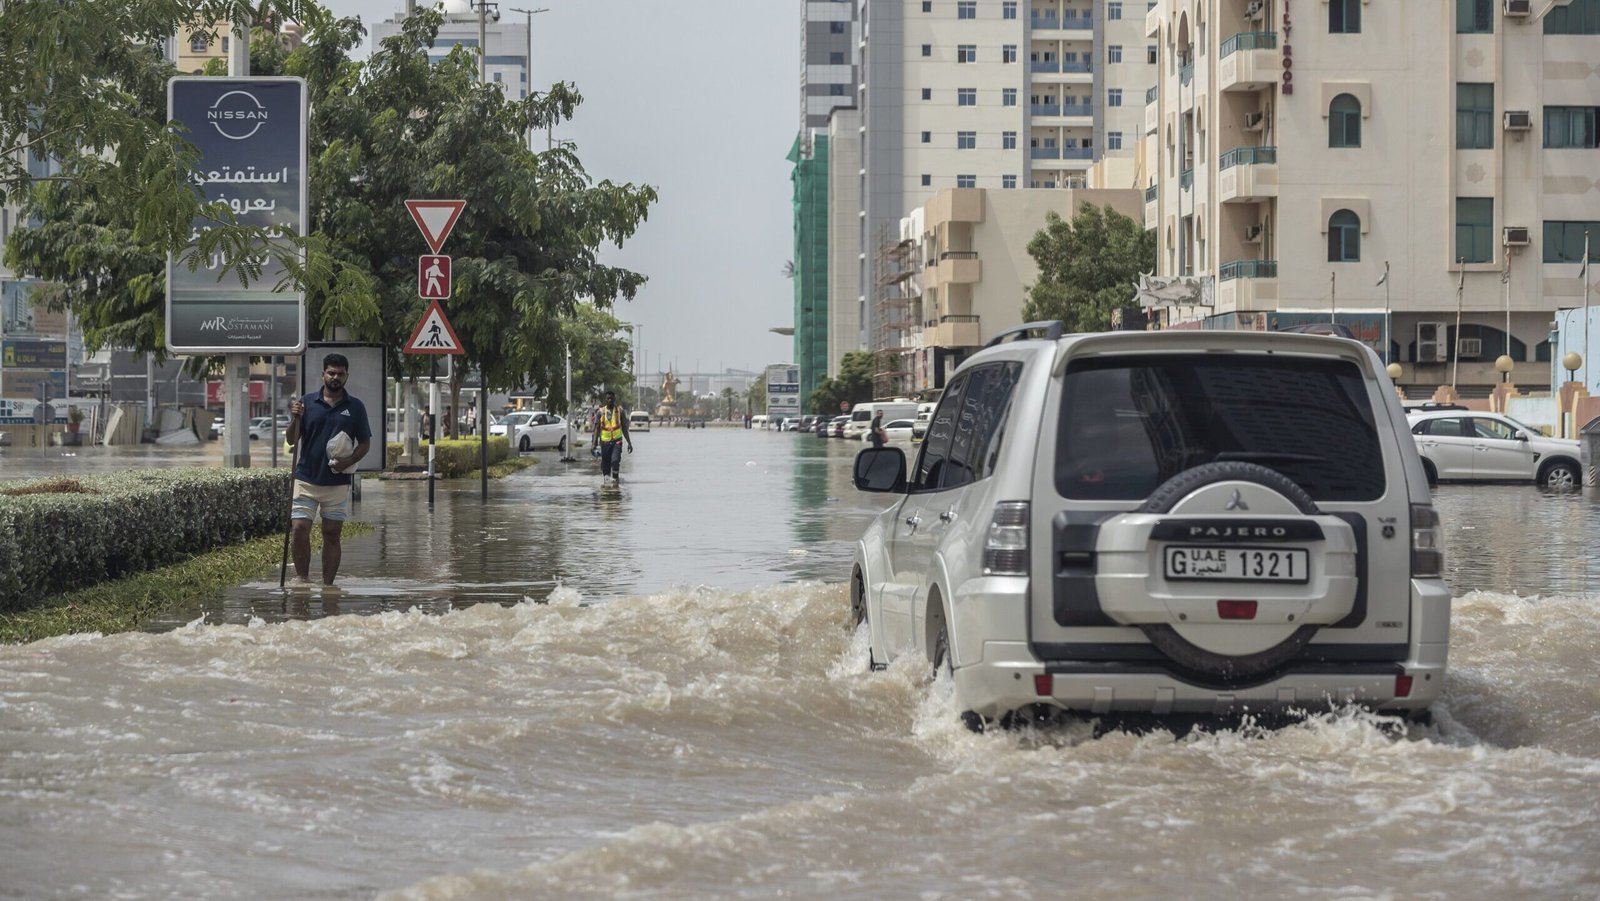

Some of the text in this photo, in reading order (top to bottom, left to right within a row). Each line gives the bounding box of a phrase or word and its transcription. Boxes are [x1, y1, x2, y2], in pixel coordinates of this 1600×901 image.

[1282, 45, 1292, 94] ROOM
[207, 110, 268, 119] NISSAN
[1190, 527, 1286, 536] PAJERO
[1171, 550, 1187, 575] G
[1239, 552, 1293, 577] 1321
